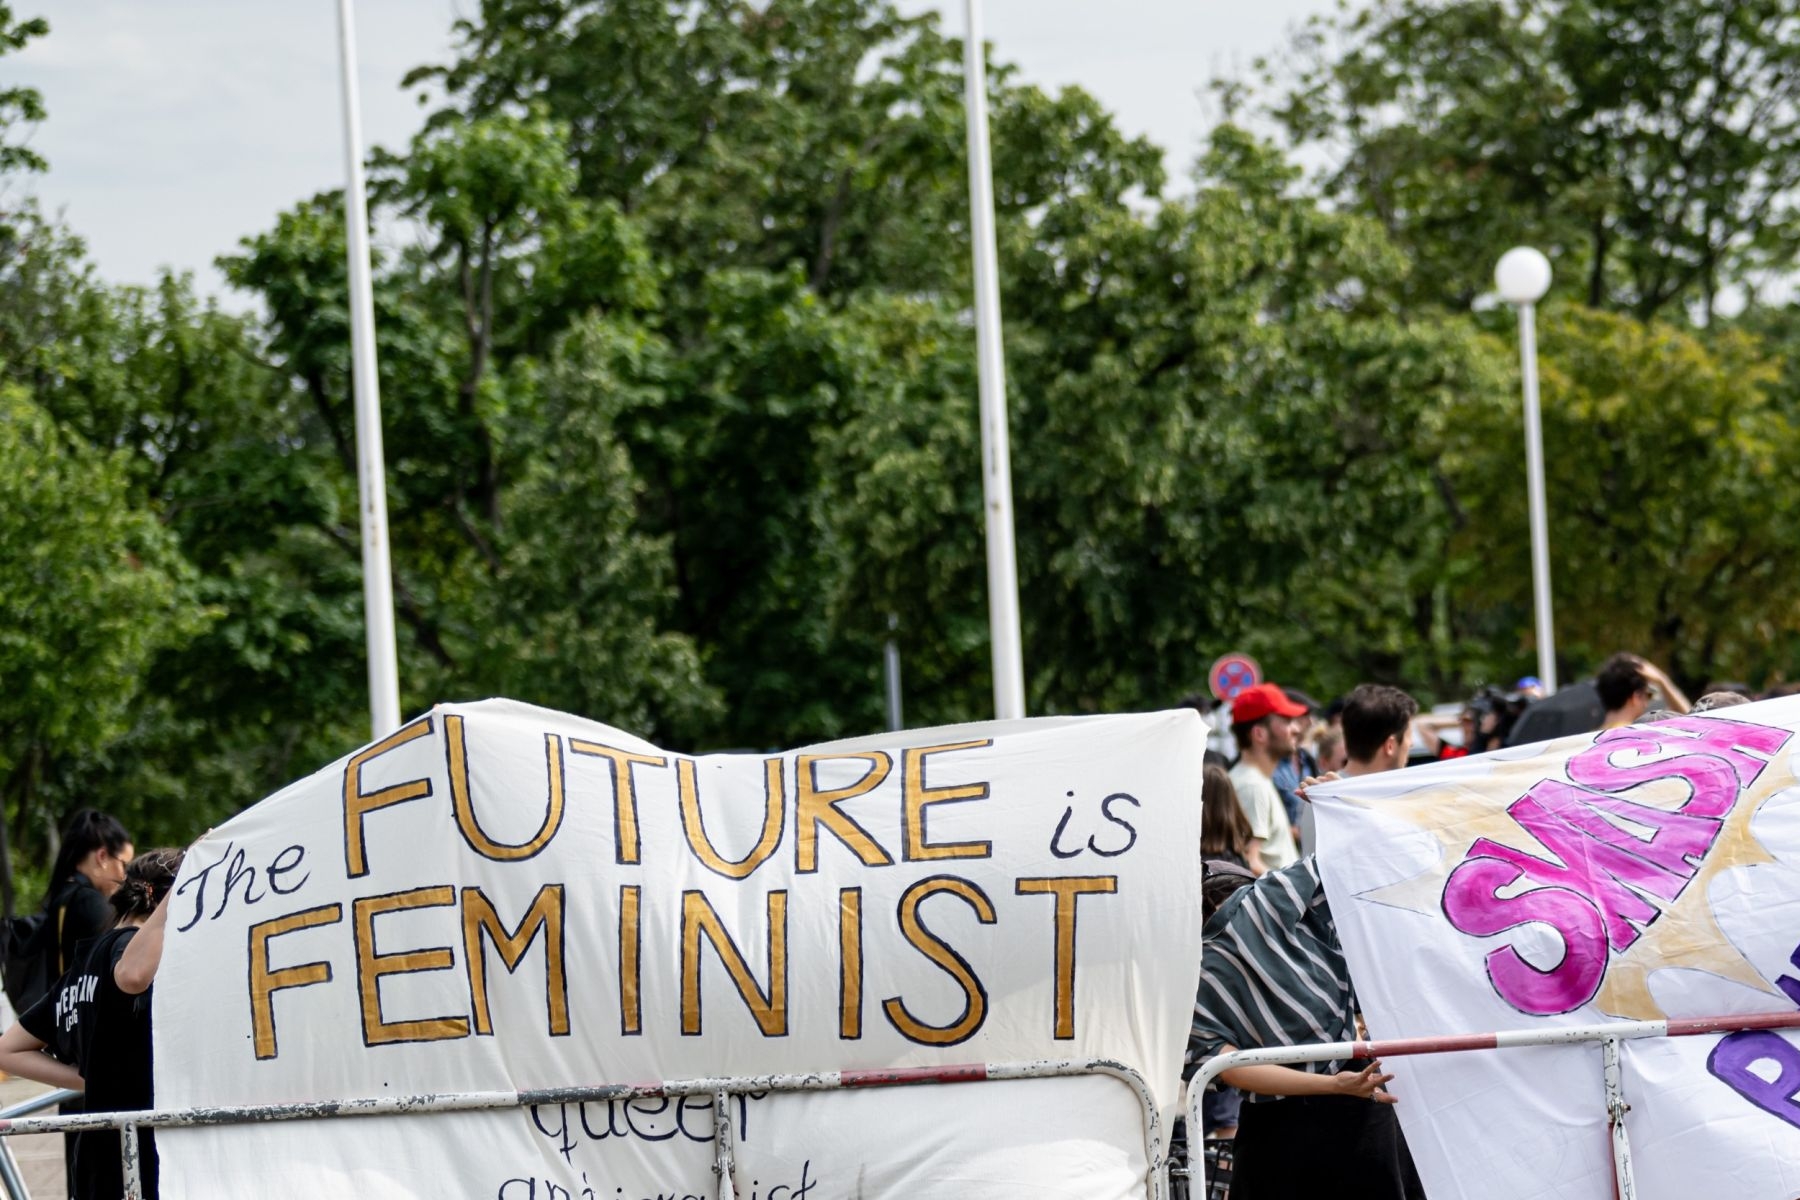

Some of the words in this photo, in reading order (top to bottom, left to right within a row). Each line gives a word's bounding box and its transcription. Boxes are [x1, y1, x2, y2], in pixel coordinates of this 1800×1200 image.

[176, 842, 310, 933] The
[342, 714, 994, 881] FUTURE
[1049, 790, 1141, 859] is
[1440, 716, 1795, 1017] SMASH
[247, 873, 1118, 1061] FEMINIST
